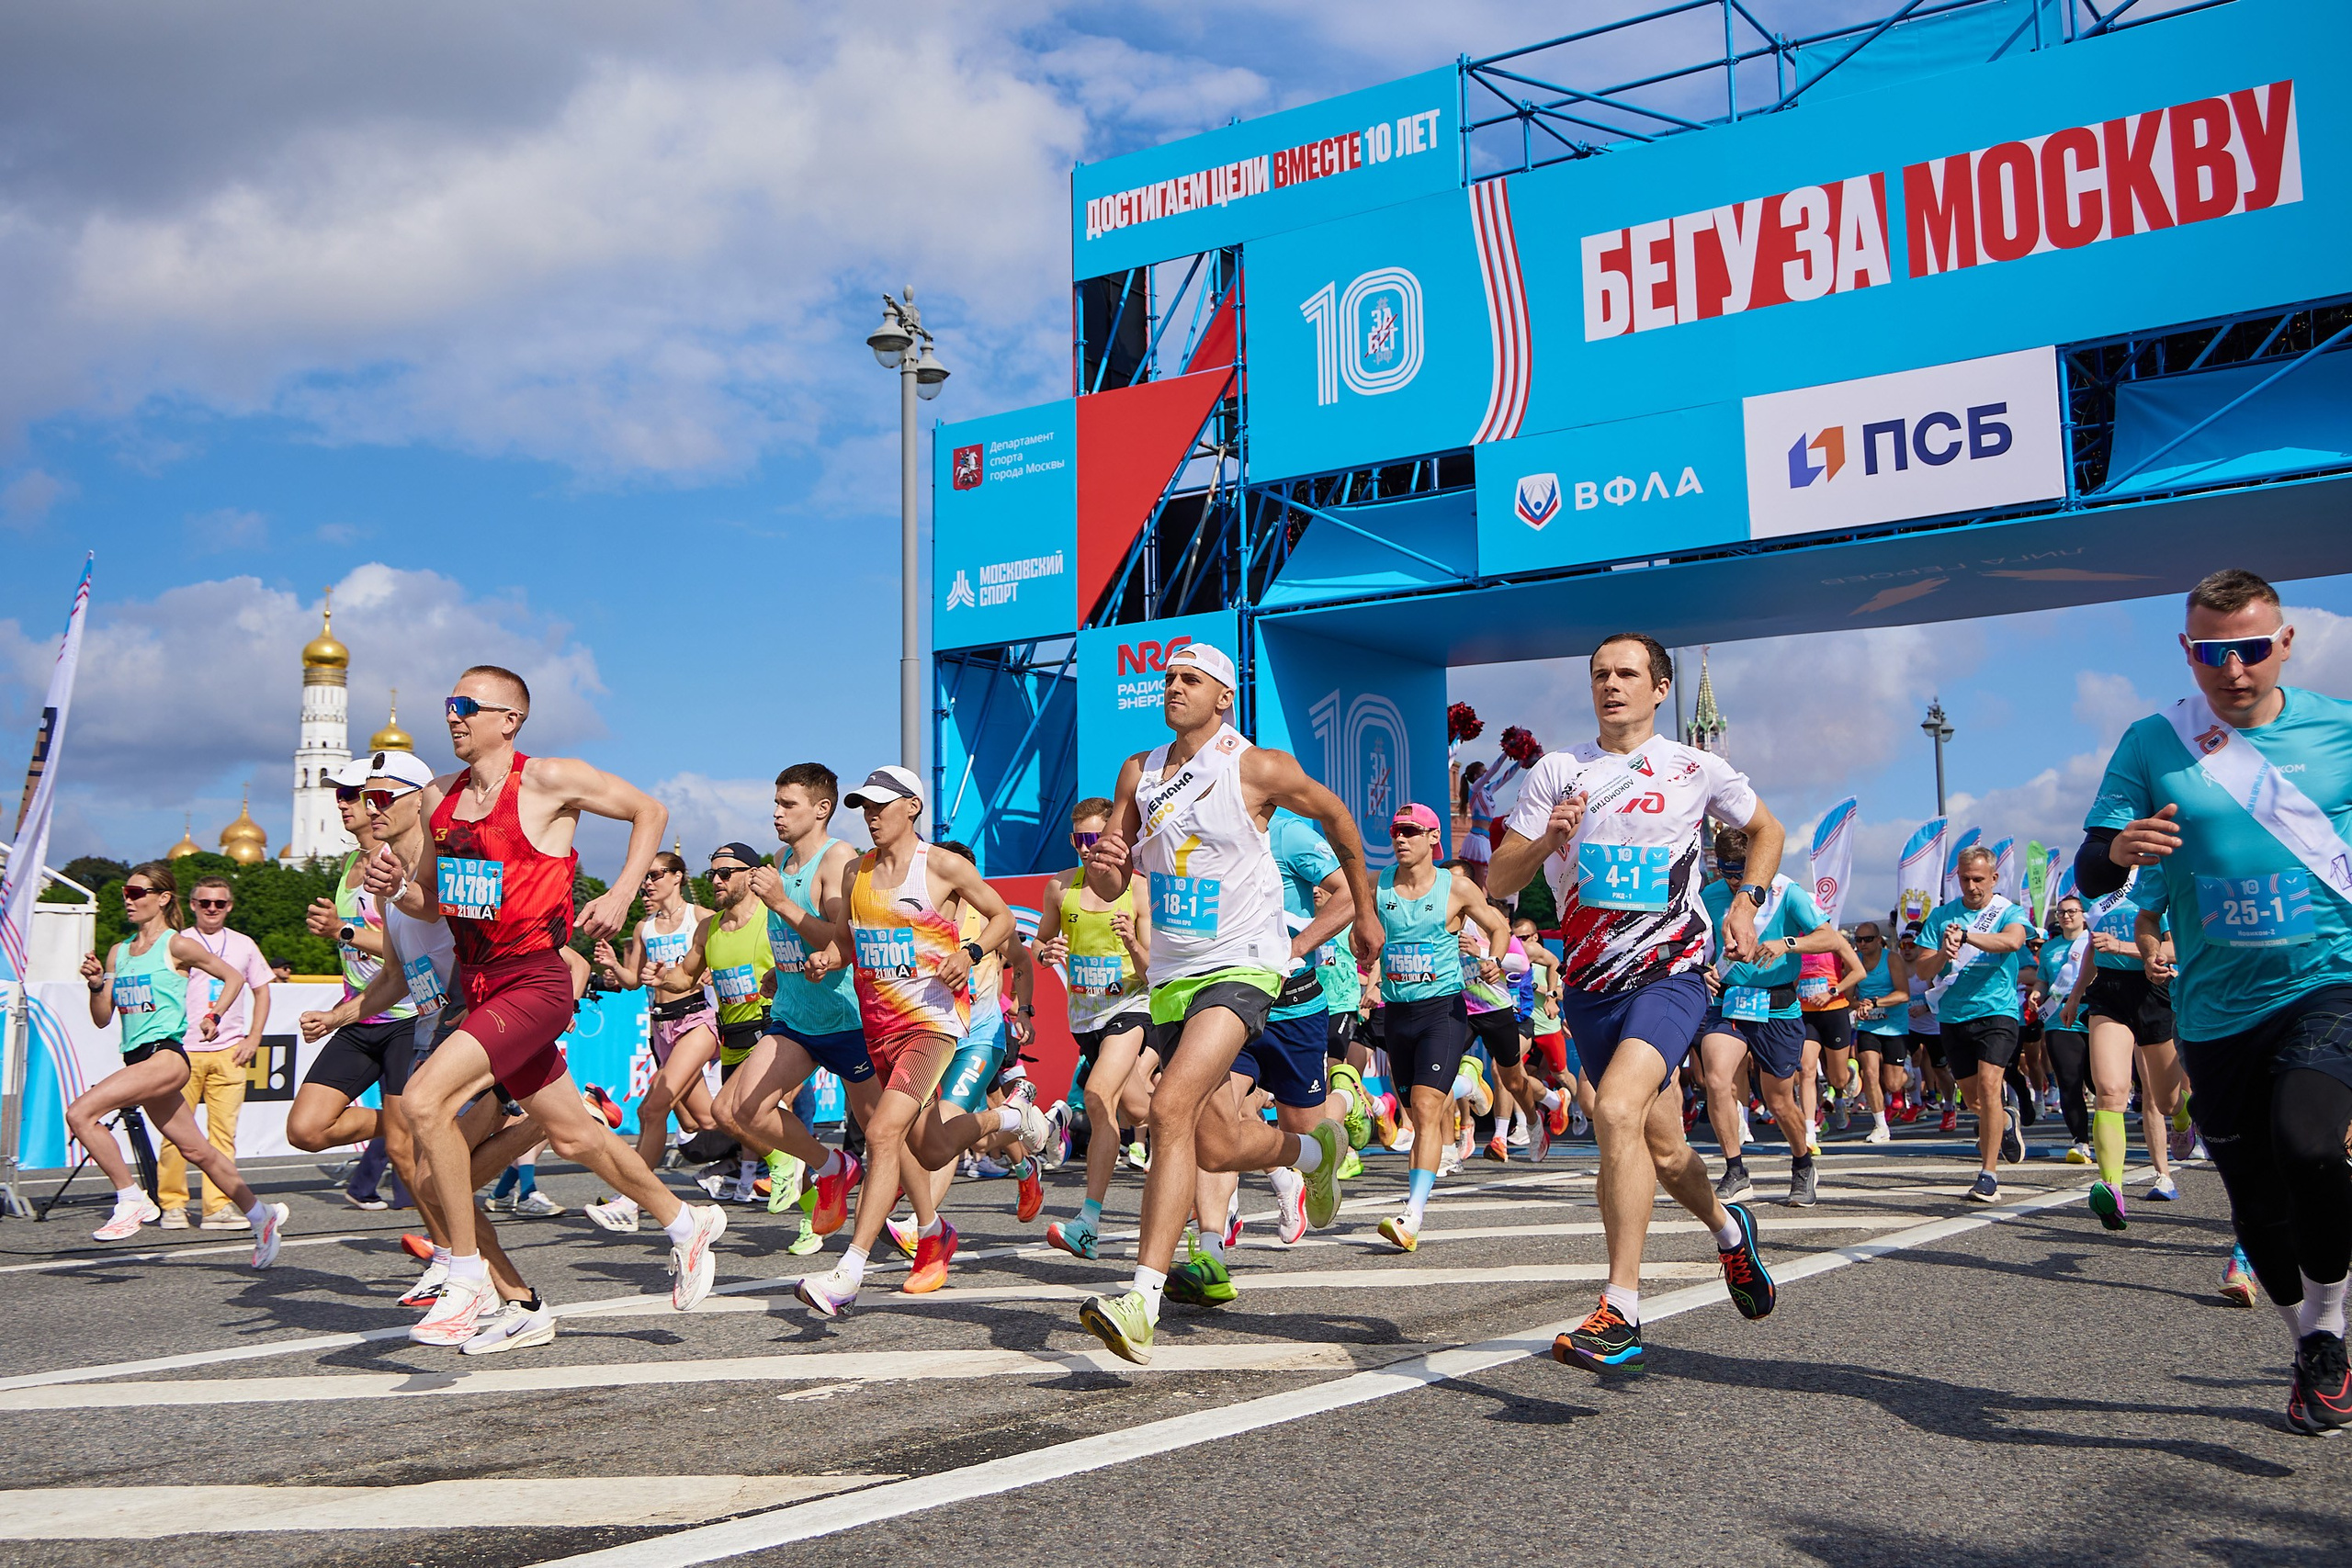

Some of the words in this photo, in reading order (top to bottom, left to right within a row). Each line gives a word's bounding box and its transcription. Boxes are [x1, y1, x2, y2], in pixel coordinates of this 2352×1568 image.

[1086, 169, 1207, 241] ДОСТИГАЕМ
[1211, 154, 1269, 207] ЦЕЛИ
[1273, 130, 1362, 189] ВМЕСТЕ
[1365, 123, 1391, 164] 10
[1396, 108, 1441, 157] ЛЕТ
[1581, 198, 1763, 342] БЕГУ
[1780, 172, 1891, 302] ЗА
[1904, 80, 2299, 278] МОСКВУ
[1300, 266, 1424, 406] 10
[989, 432, 1055, 454] Департамент
[1862, 401, 2013, 476] ПСБ
[989, 453, 1023, 466] спорта
[989, 467, 1023, 481] города
[1025, 459, 1065, 474] Москвы
[1574, 467, 1704, 511] ВФЛА
[979, 549, 1064, 585] МОСКОВСКИЙ
[979, 581, 1019, 607] СПОРТ
[1117, 694, 1165, 710] ЭНЕРД
[1590, 779, 1634, 814] ЛОКОМОТИВ
[1606, 865, 1640, 889] 4-1
[445, 874, 497, 905] 74781
[1163, 893, 1197, 918] 18-1
[2223, 897, 2285, 925] 25-1
[649, 942, 685, 963] 74536
[860, 942, 910, 966] 75701
[1387, 953, 1432, 973] 75502
[407, 969, 441, 1003] 5697
[717, 975, 754, 996] 76815
[1075, 965, 1115, 987] 71557
[115, 985, 153, 1006] 75700
[1802, 983, 1827, 998] 75503
[1735, 996, 1758, 1010] 15-1
[952, 1055, 987, 1096] FILA
